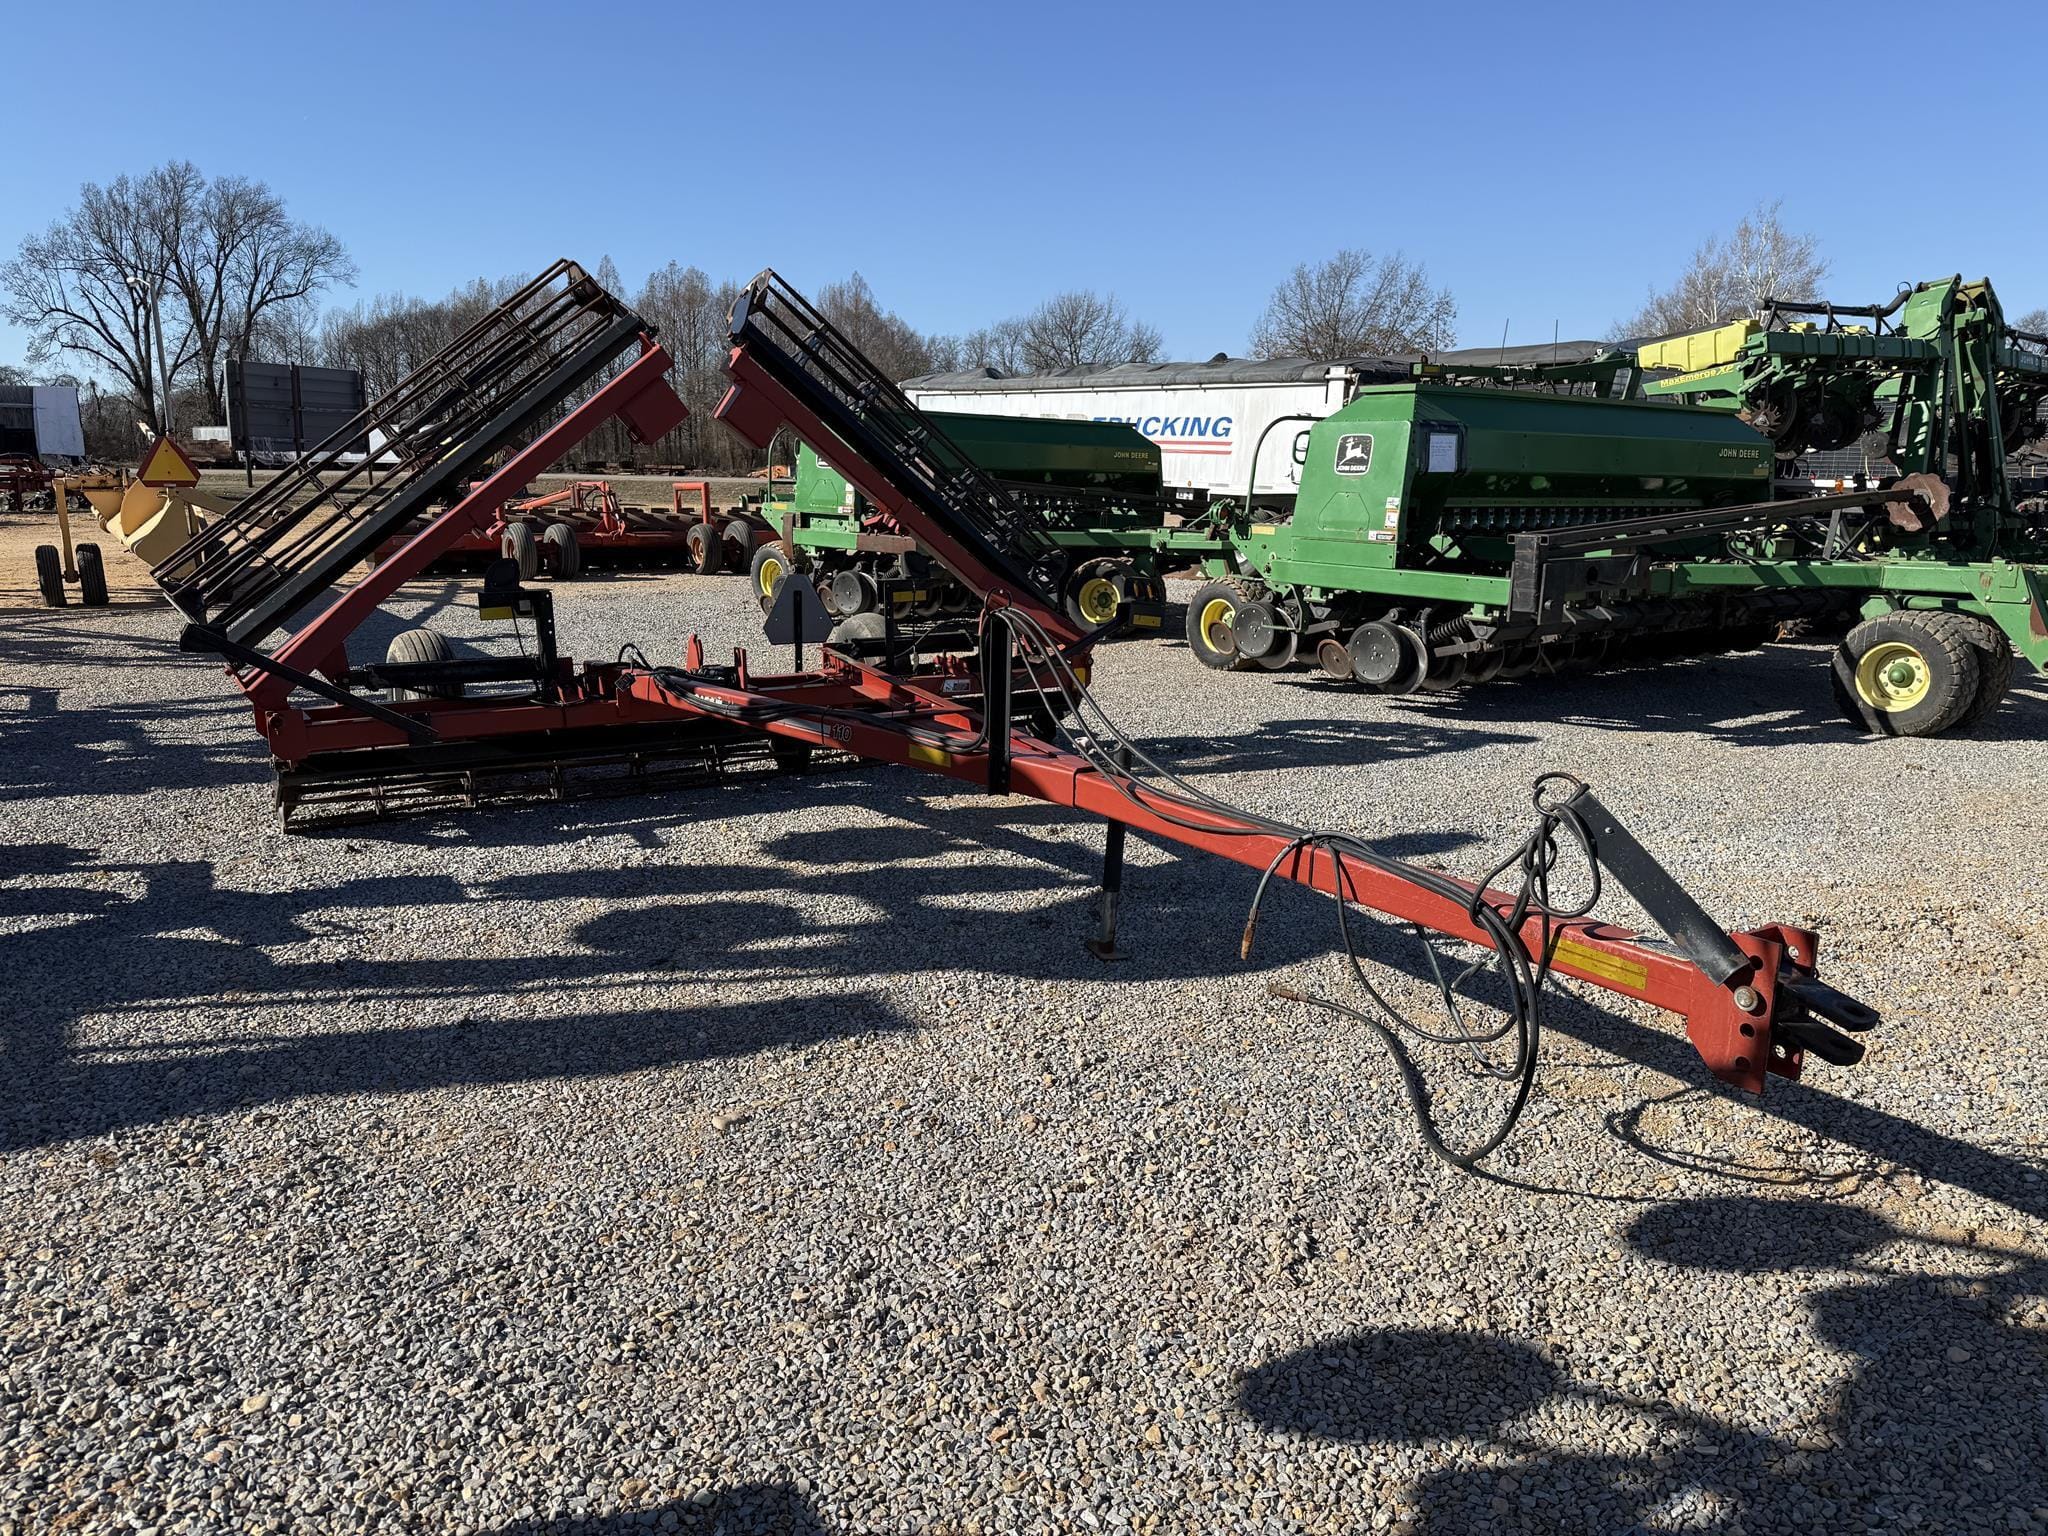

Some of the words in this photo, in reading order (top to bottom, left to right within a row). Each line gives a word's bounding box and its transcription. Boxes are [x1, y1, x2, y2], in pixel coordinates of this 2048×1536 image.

[1093, 416, 1233, 437] UCKING
[1113, 451, 1130, 459] JOHN
[1718, 447, 1737, 457] JOHN
[1739, 449, 1760, 459] DEERE
[832, 723, 852, 741] 110
